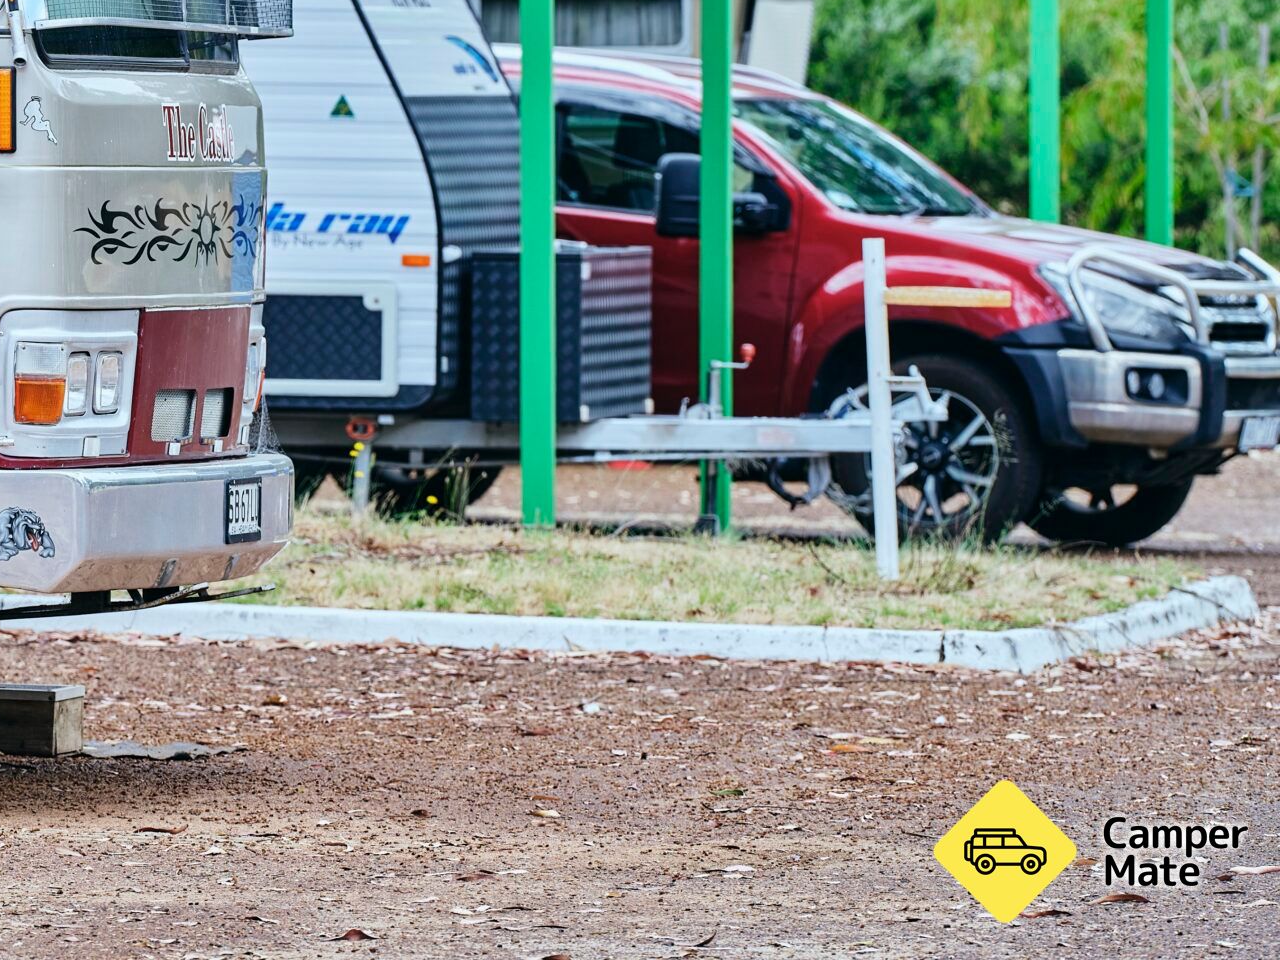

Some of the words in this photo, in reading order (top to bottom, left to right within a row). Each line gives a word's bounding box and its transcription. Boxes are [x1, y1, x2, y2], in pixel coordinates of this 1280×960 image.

[161, 102, 196, 162] The
[198, 102, 235, 163] Castle
[317, 213, 410, 244] ray
